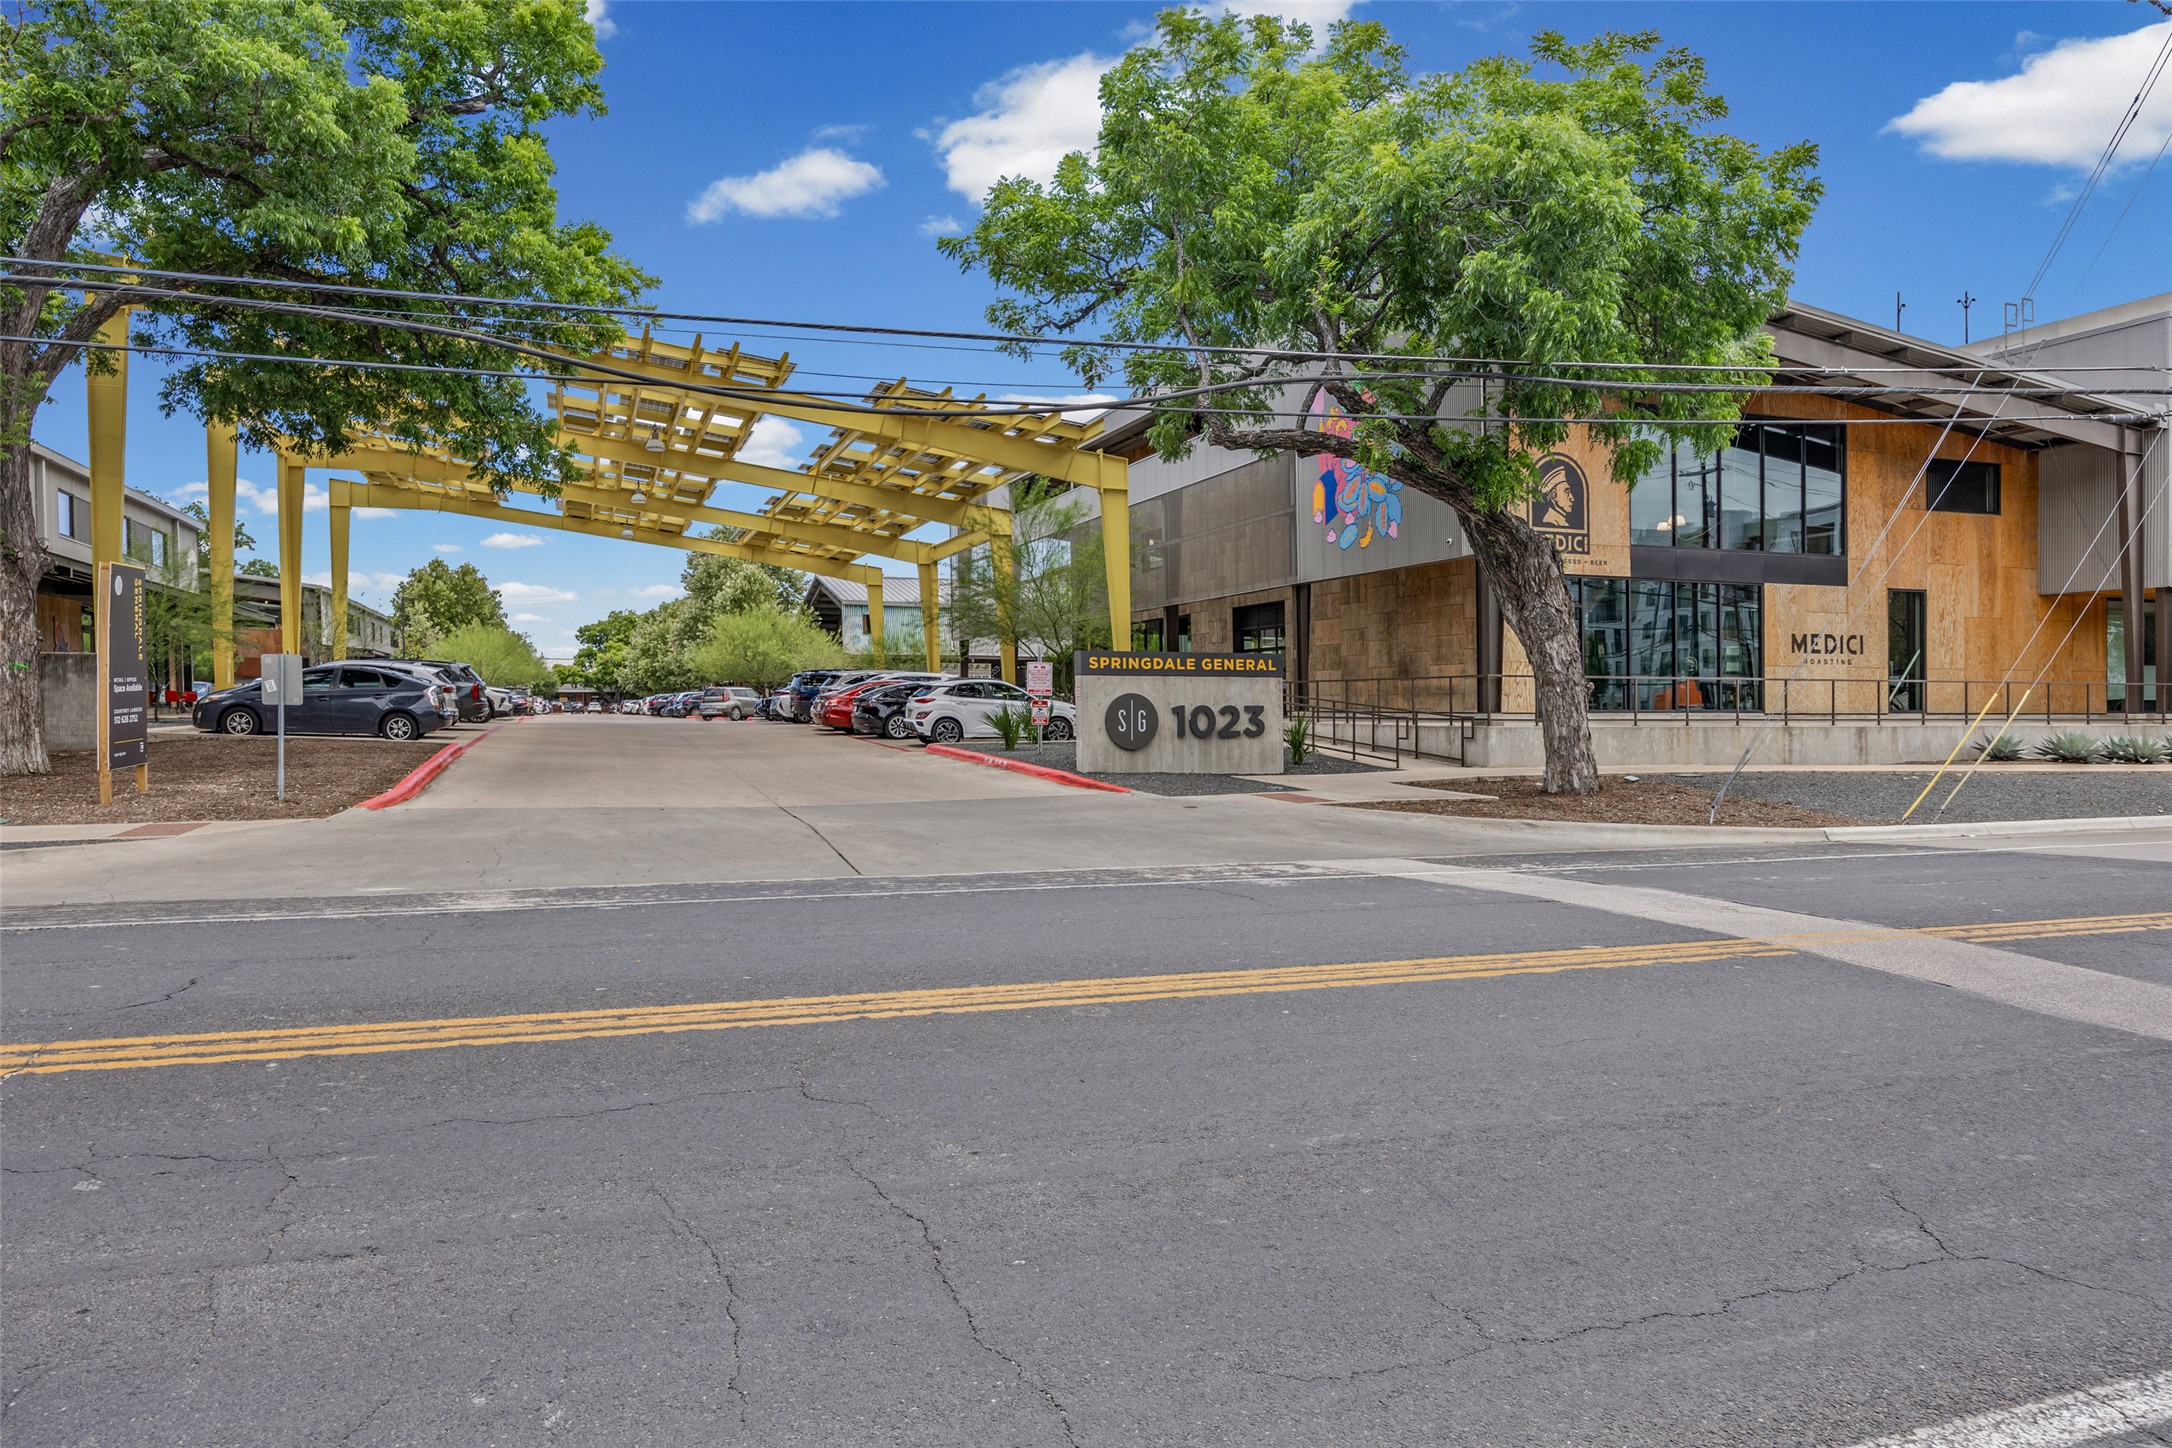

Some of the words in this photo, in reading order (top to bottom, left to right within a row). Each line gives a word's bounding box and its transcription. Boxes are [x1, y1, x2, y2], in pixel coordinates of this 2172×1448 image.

[1548, 534, 1588, 552] DICI
[1791, 633, 1864, 655] MEDICI
[1088, 656, 1196, 671] SPRINGDALE
[1201, 658, 1277, 671] GENERAL
[1171, 705, 1265, 738] 1023
